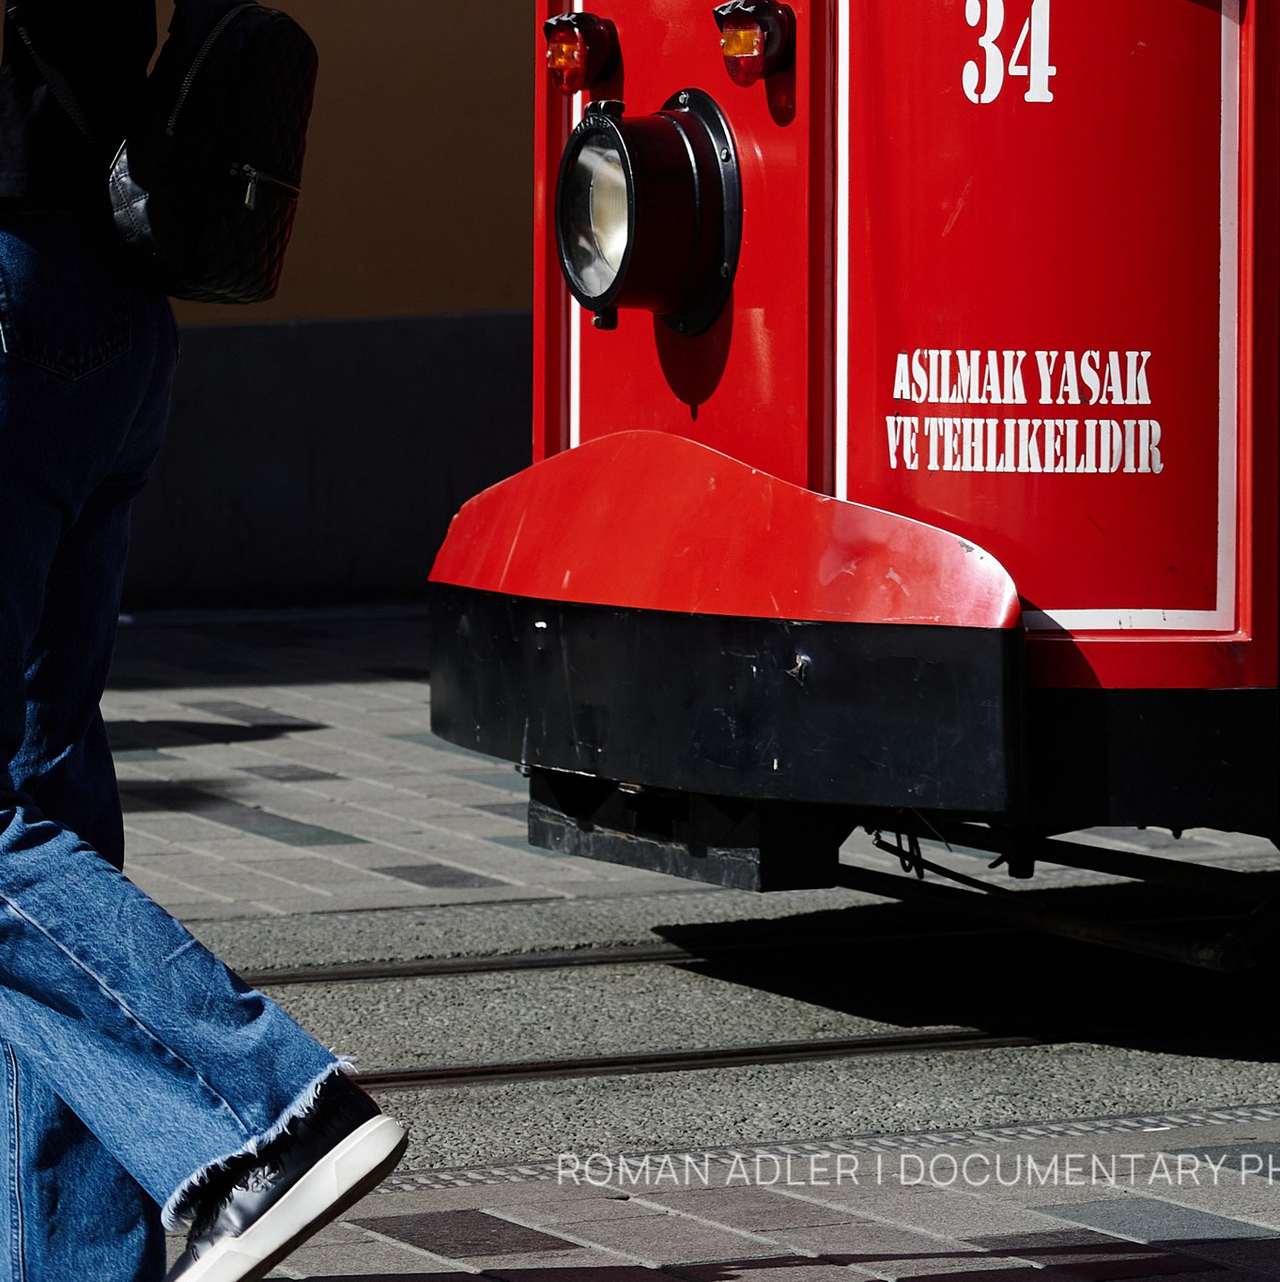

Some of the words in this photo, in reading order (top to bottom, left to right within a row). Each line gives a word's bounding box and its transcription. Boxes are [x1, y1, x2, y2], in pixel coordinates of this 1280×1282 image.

[893, 348, 1027, 404] ASILMAK
[1034, 349, 1152, 405] YASAK
[886, 415, 919, 470] VE
[924, 417, 1164, 475] TEHLIKELIDIR
